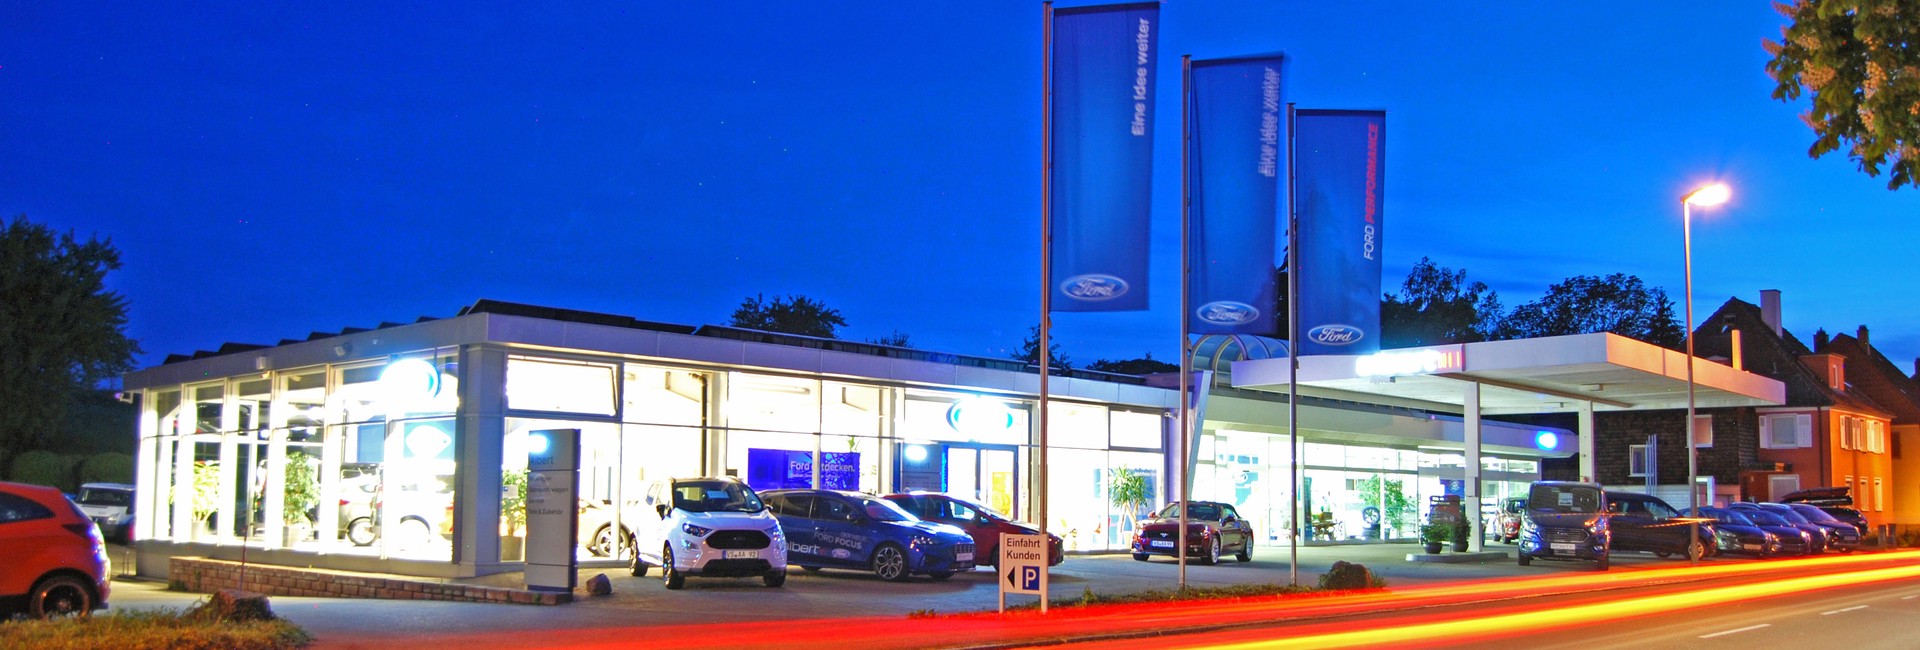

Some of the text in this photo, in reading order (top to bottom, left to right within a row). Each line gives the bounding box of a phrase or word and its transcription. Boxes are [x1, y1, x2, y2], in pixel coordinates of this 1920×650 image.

[1131, 17, 1149, 136] Eine Idee weiter
[1363, 123, 1378, 260] FORD PERFORMANCE
[1318, 327, 1353, 342] Ford
[790, 461, 810, 471] Ford
[814, 531, 862, 549] FORD FOCUS
[1007, 538, 1040, 548] Einfahrt
[1007, 550, 1040, 560] Kunden
[1025, 568, 1037, 588] P
